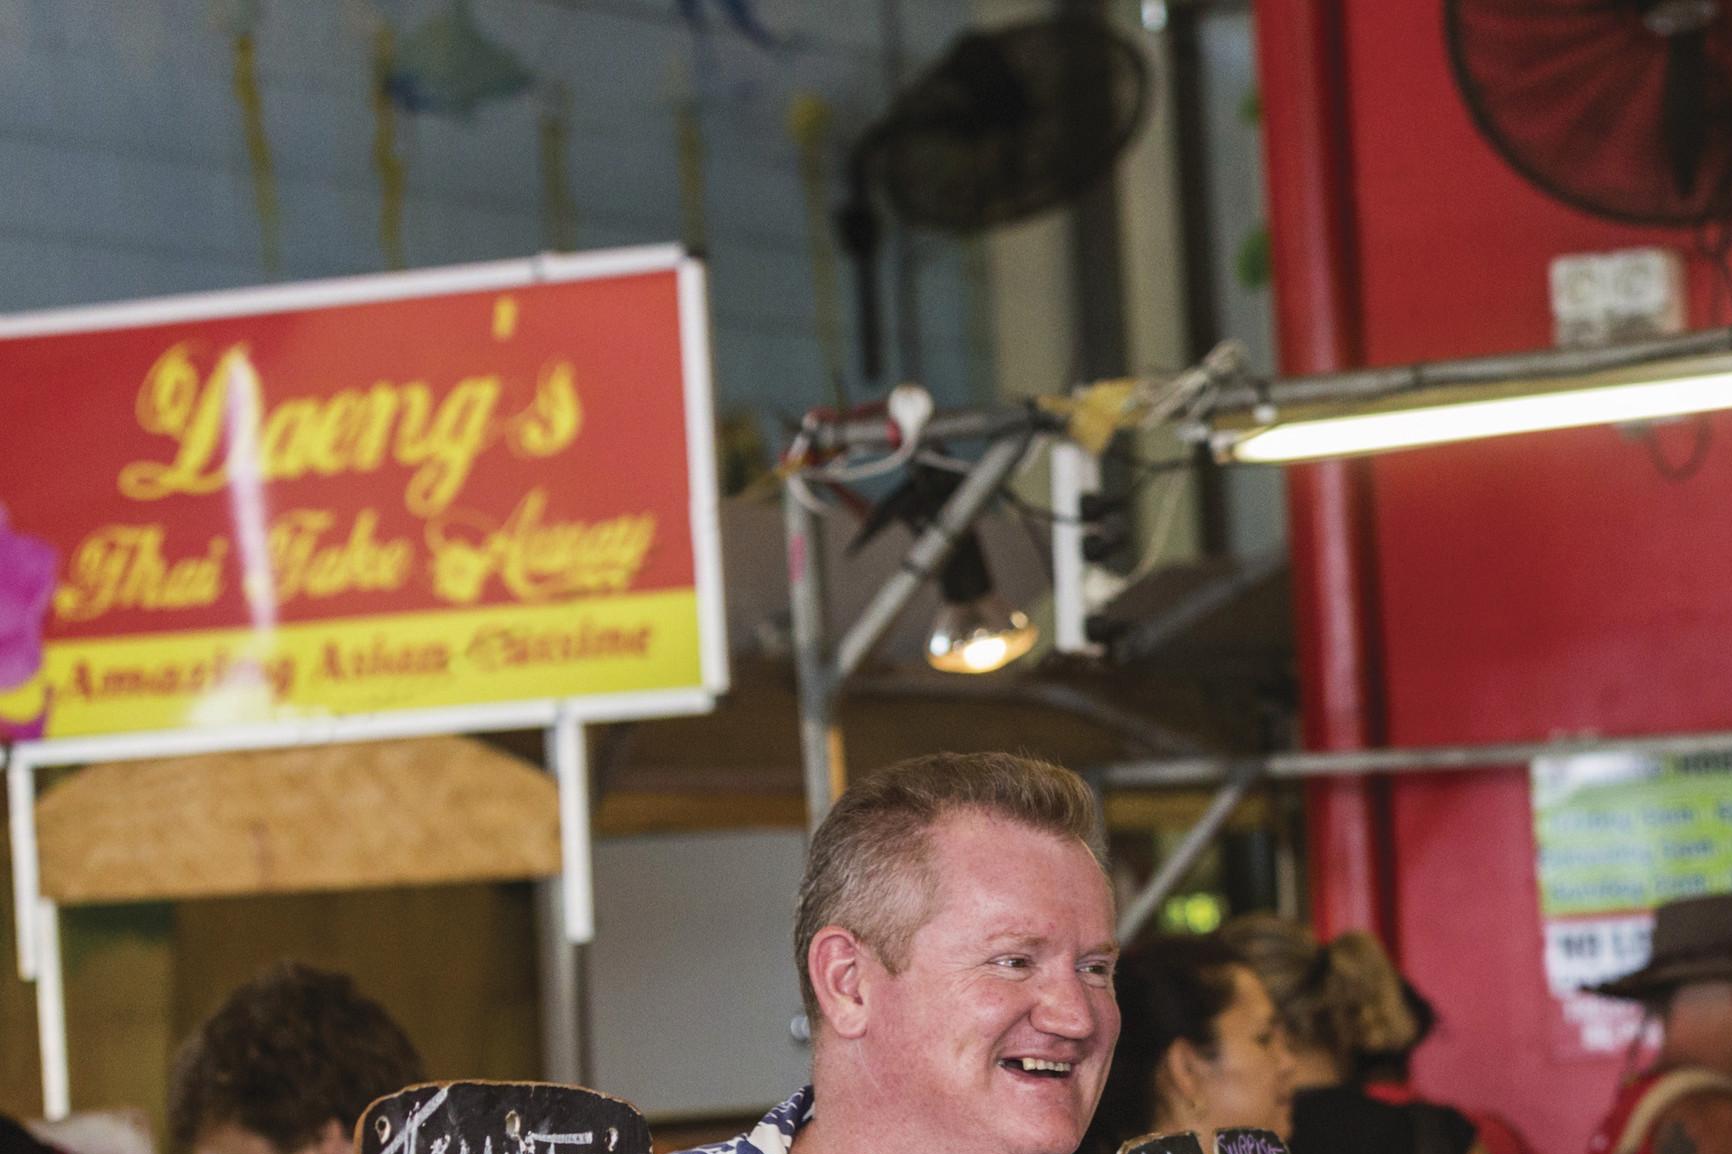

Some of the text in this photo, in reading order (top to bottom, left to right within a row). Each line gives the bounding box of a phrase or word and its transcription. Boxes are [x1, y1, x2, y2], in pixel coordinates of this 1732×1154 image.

[55, 486, 657, 622] Thai Take Away
[62, 645, 297, 703] Amazig
